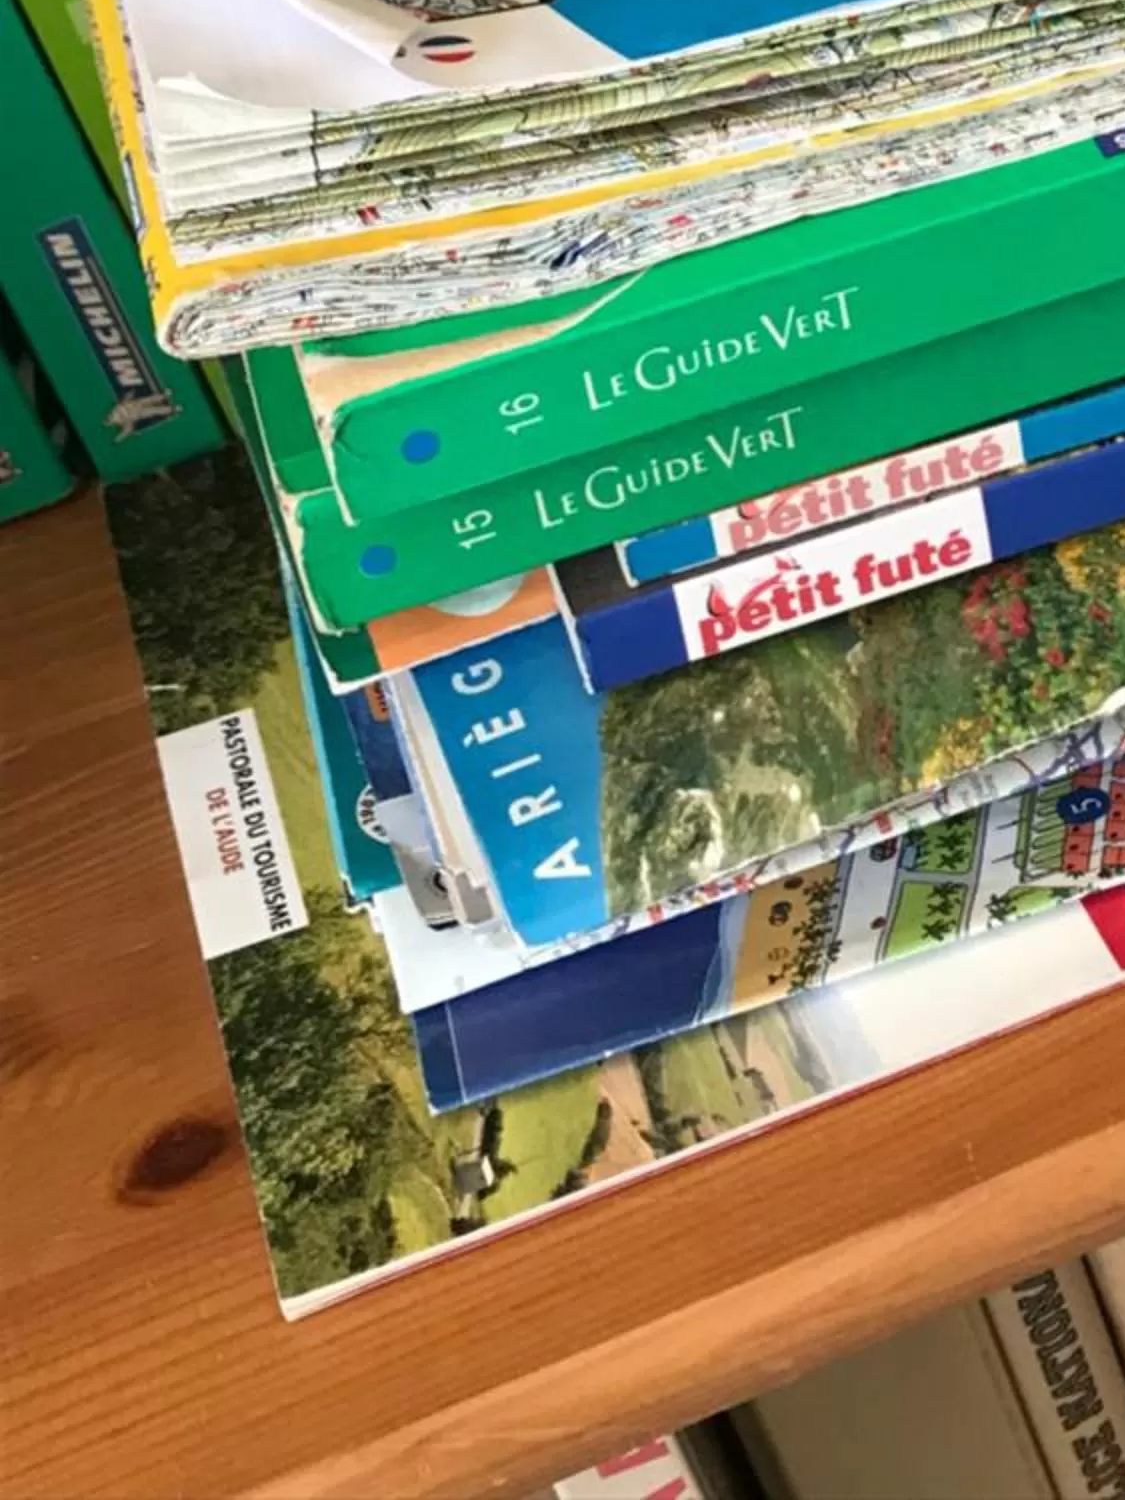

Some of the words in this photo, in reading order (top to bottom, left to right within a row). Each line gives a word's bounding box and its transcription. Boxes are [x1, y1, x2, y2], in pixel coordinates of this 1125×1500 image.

[46, 233, 143, 387] MICHELIN
[499, 390, 544, 436] 16
[727, 473, 873, 552] petit
[883, 433, 1007, 504] futé
[453, 508, 498, 552] 15
[697, 566, 845, 658] petit
[853, 528, 973, 598] futé
[220, 716, 261, 810] PASTORALE
[205, 787, 229, 812] DE
[243, 811, 269, 839] DU
[1070, 795, 1103, 823] 5
[212, 813, 245, 875] L'AUDE
[250, 840, 292, 932] TOURISME
